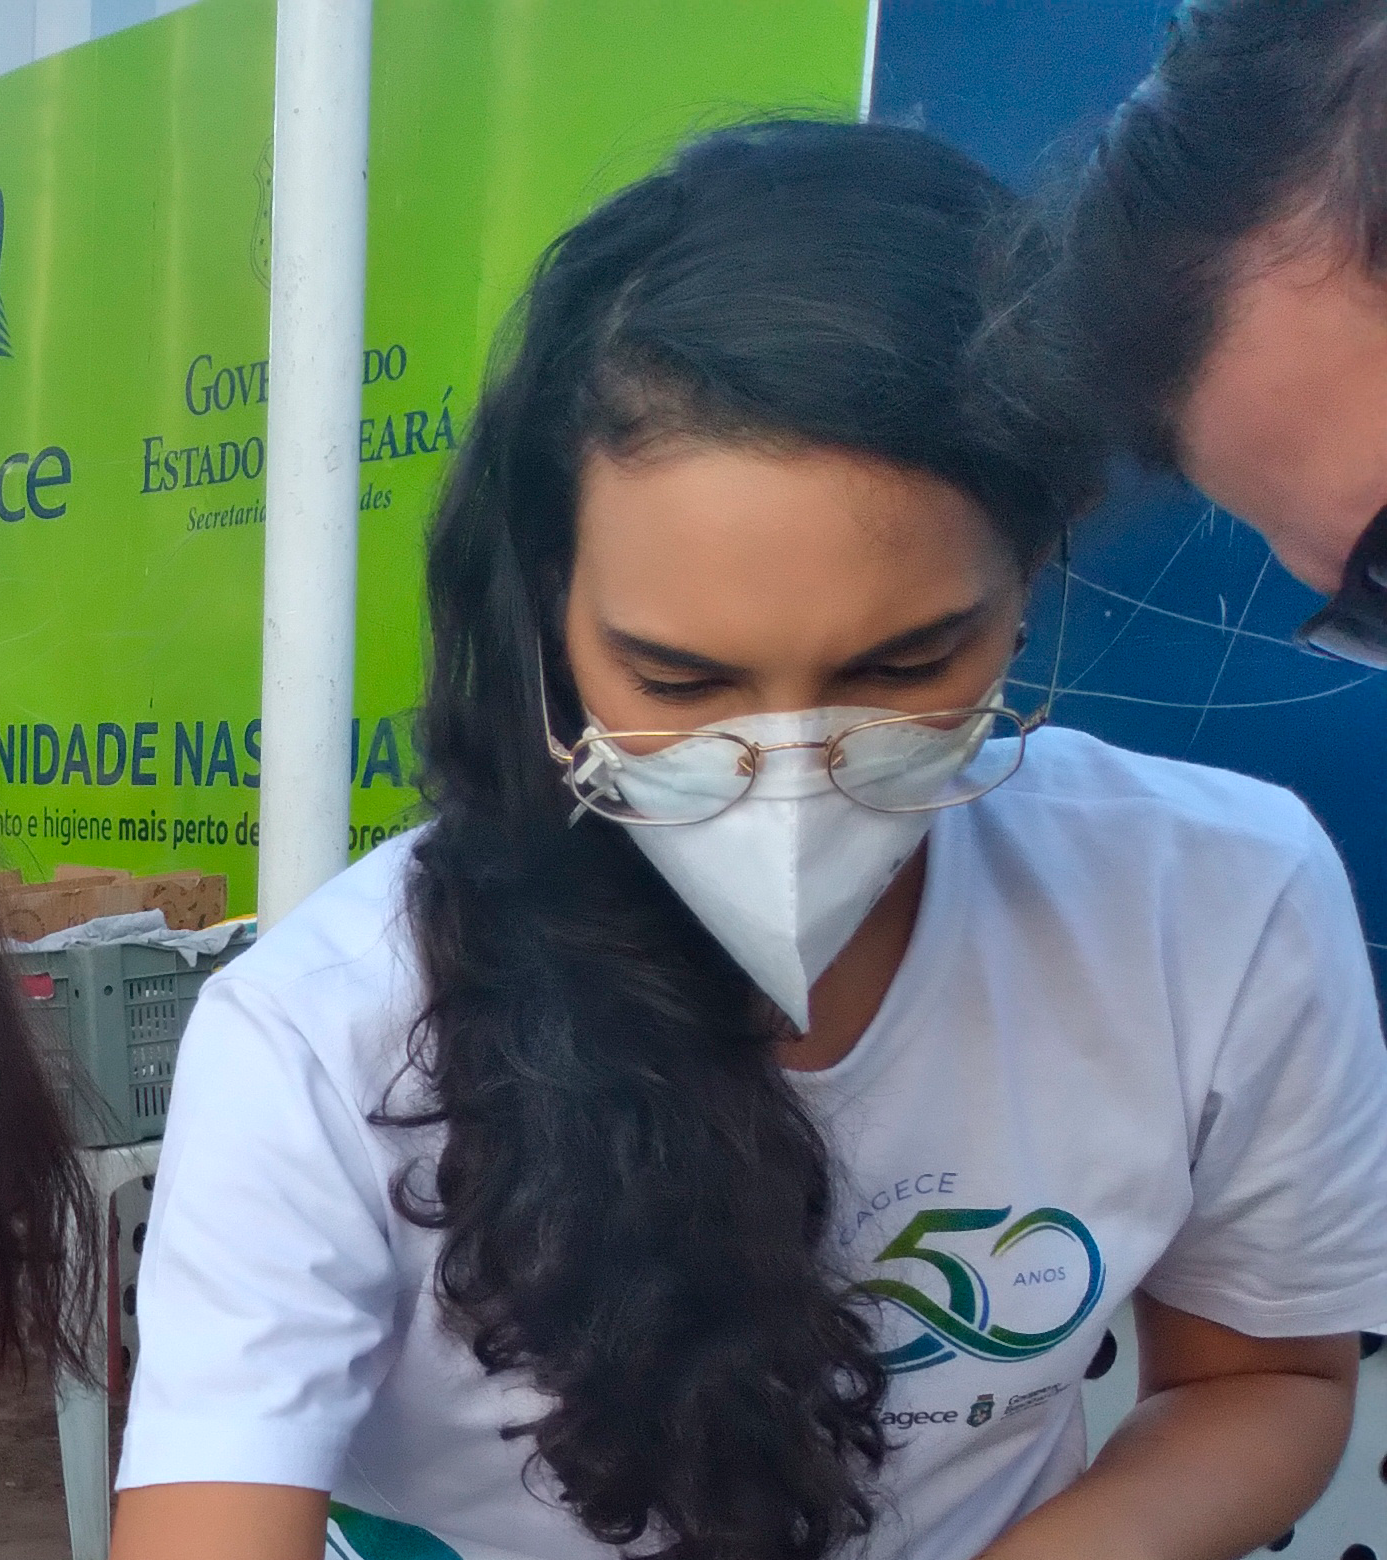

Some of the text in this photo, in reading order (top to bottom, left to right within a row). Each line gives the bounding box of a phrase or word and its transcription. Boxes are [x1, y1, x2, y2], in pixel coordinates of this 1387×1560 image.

[141, 386, 459, 495] ESTADO EARÁ
[27, 817, 39, 839] e
[43, 807, 113, 846] higiene
[118, 810, 167, 843] mais
[173, 812, 228, 850] perto
[1013, 1265, 1067, 1287] ANOS
[880, 1404, 959, 1430] agece
